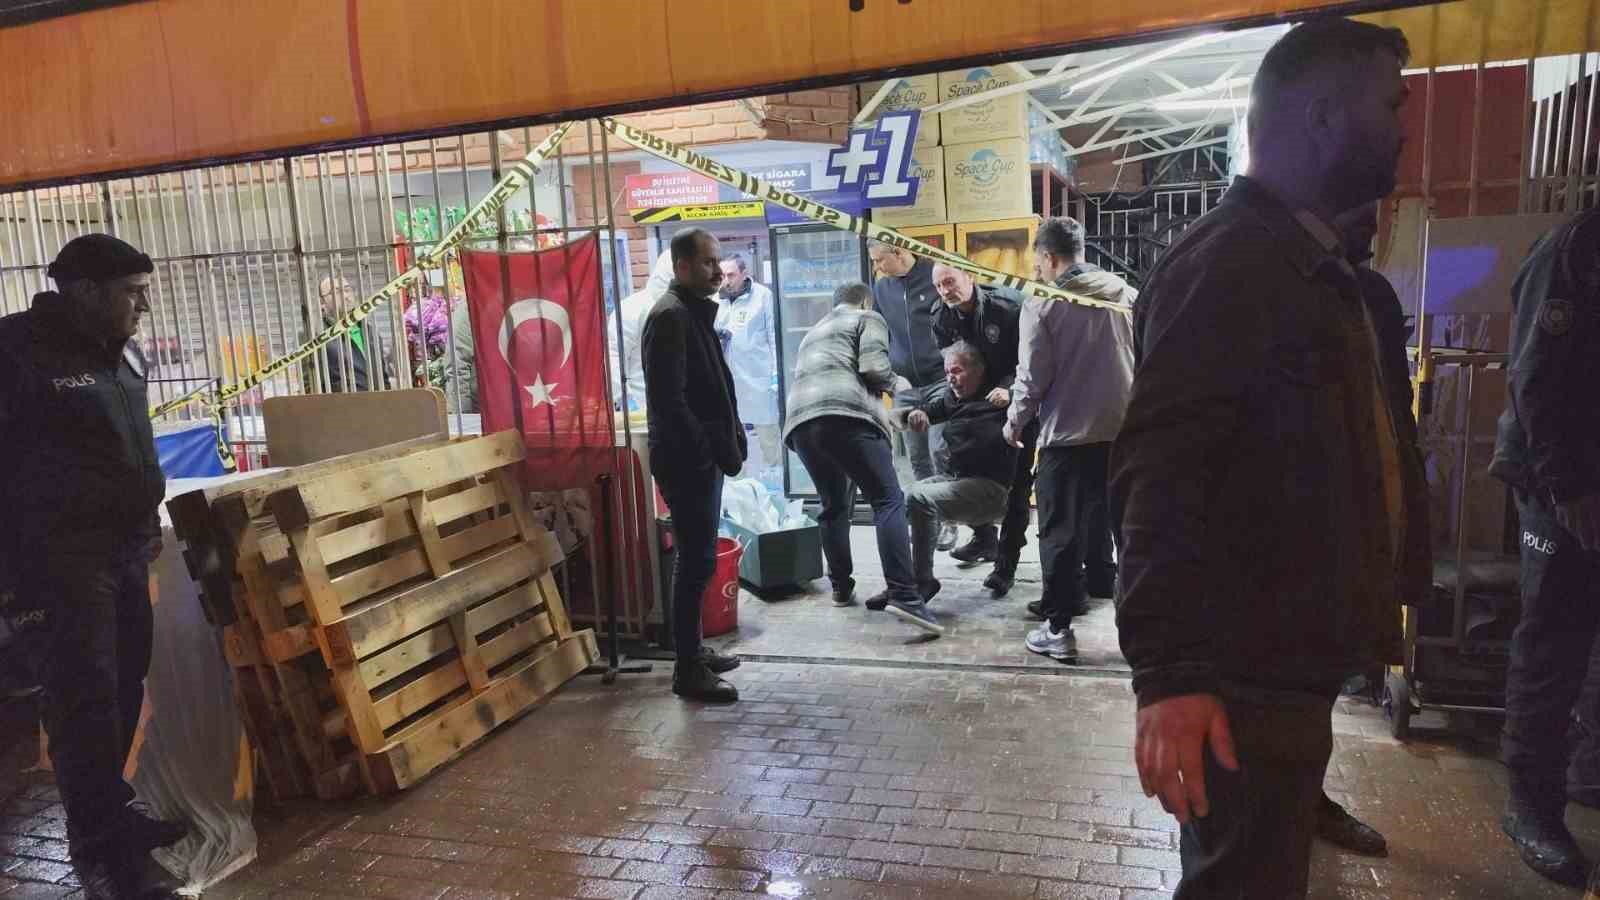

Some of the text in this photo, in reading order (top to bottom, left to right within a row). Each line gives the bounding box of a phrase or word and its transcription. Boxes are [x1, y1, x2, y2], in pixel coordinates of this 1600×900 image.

[829, 112, 916, 202] +1
[953, 158, 1015, 178] Space Cup
[52, 373, 96, 390] POLİS
[1523, 531, 1558, 554] POLİS
